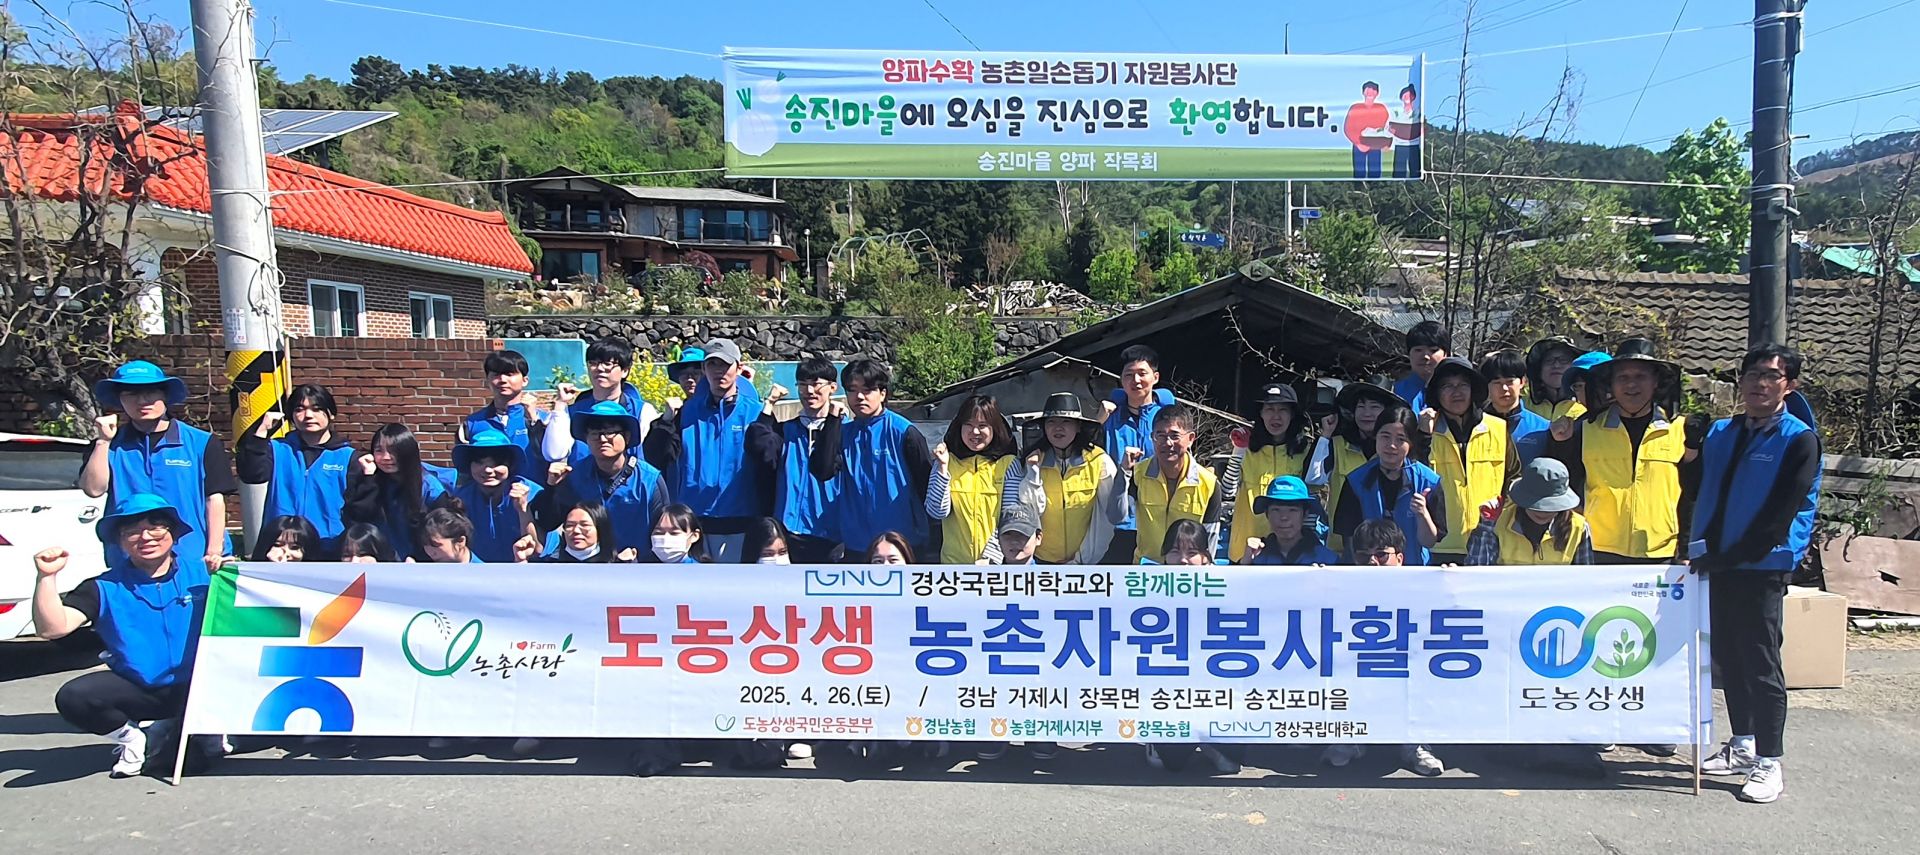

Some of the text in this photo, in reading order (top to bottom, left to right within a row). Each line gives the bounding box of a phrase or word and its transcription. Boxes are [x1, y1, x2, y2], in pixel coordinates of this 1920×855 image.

[882, 58, 1238, 86] 양파수확 농촌일손돕기 자원봉사단
[785, 93, 1338, 137] 송진마을에 오심을 진심으로 환영합니다.
[977, 151, 1158, 172] 송진마을 양파 작목회
[911, 571, 1114, 597] 경상국립대학교와
[1124, 572, 1227, 598] 함께하는
[530, 641, 556, 650] Farm
[601, 603, 1489, 679] 도농상생 농촌자원봉사활동
[470, 654, 565, 679] 농촌사랑
[740, 686, 791, 706] 2025.
[801, 687, 818, 706] 4.
[958, 686, 997, 708] 경남
[1009, 687, 1067, 709] 거제시
[1079, 687, 1139, 709] 장목면
[1151, 688, 1232, 710] 송진포리
[1244, 688, 1349, 710] 송진포마을
[1520, 686, 1644, 711] 도농상생
[743, 716, 873, 734] 도농상생국민운동본부
[924, 718, 976, 736] 경남농협
[1009, 718, 1103, 737] 농협거제시지부
[1138, 720, 1190, 738] 장목농협
[1274, 721, 1368, 738] 경상국립대학교
